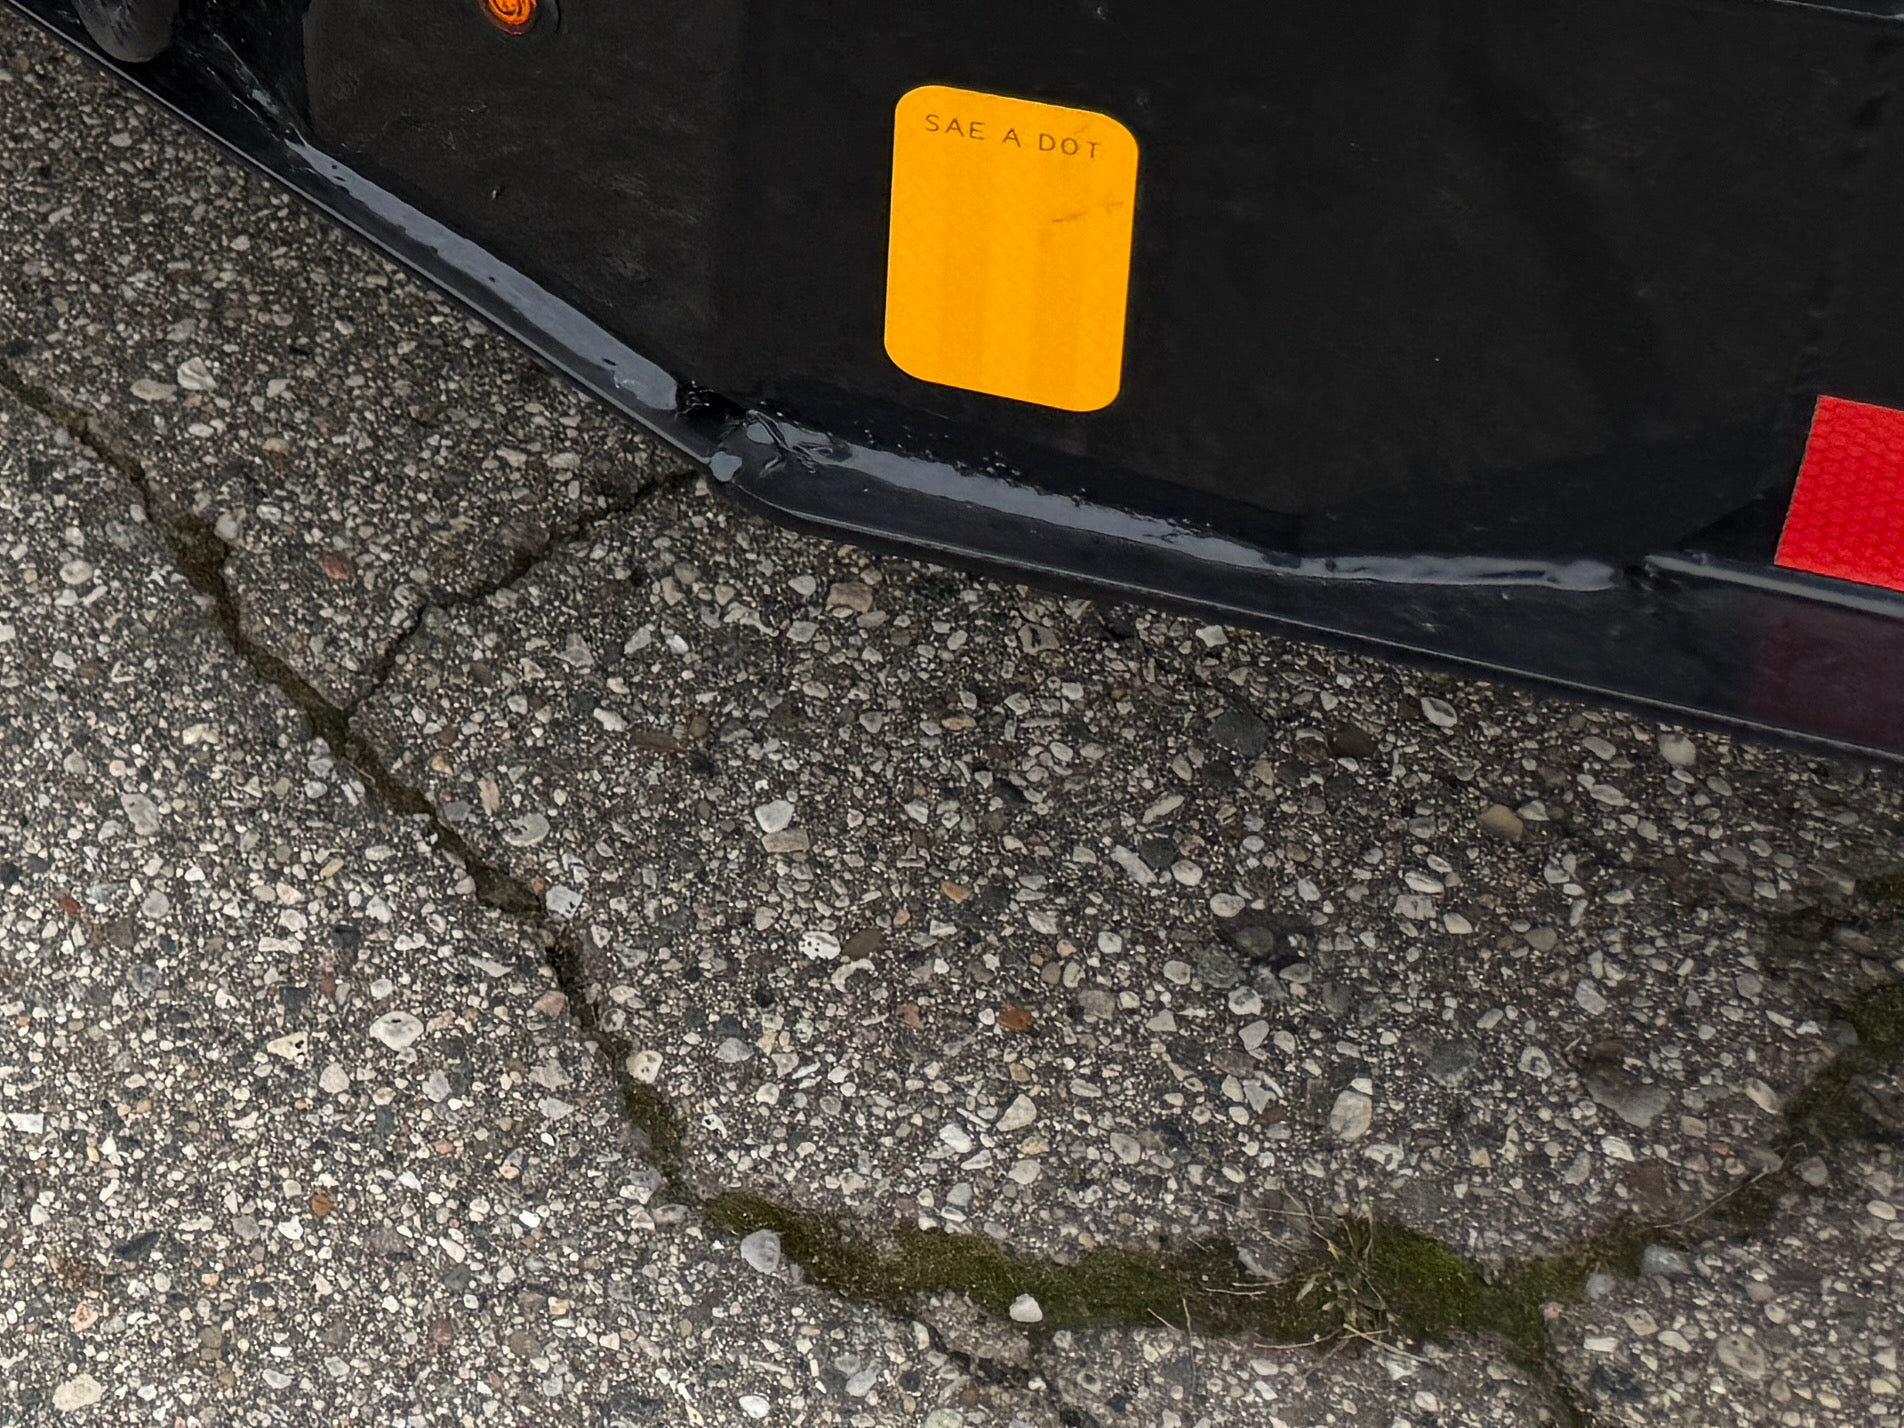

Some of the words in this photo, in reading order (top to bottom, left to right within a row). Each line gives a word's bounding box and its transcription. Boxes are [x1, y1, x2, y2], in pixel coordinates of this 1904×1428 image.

[924, 113, 986, 141] SAE
[1001, 127, 1022, 149] A
[1038, 132, 1101, 159] DOT
